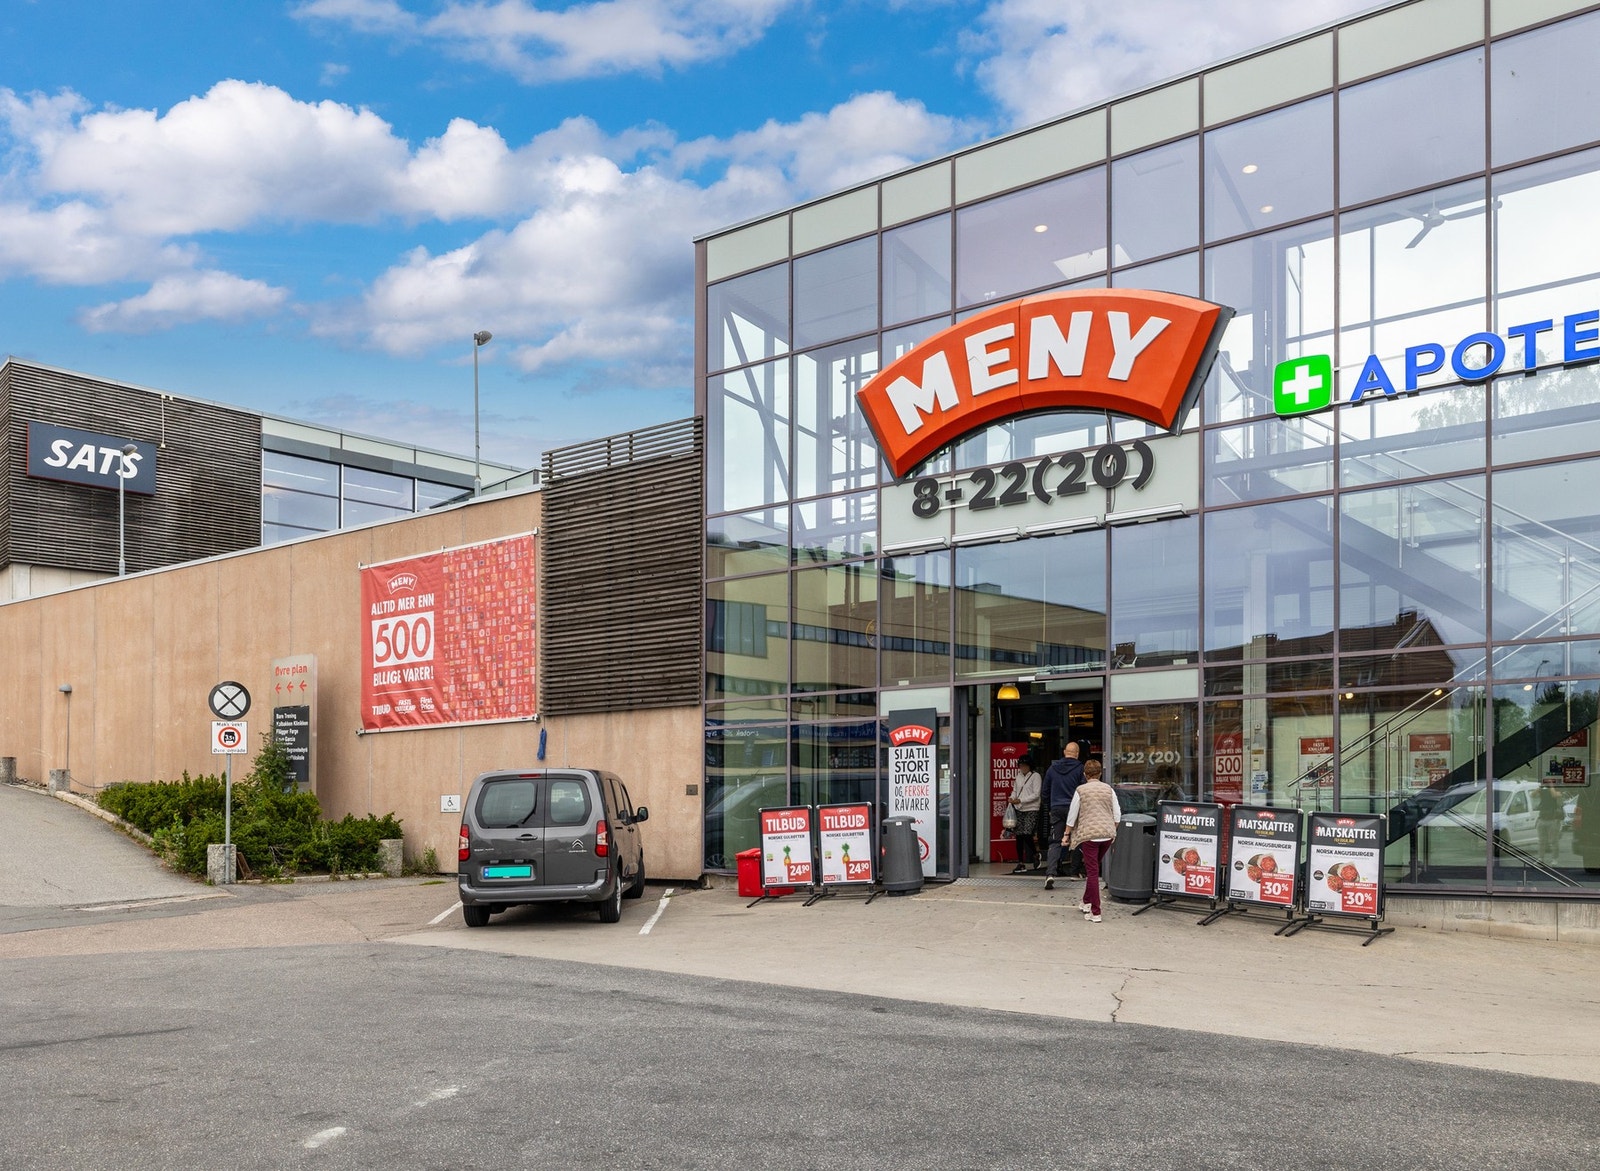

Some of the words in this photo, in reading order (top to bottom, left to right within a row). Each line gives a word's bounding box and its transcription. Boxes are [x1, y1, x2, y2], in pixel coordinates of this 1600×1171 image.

[1350, 310, 1600, 401] APOTE
[885, 311, 1172, 435] MENY
[43, 439, 143, 478] SATS
[391, 576, 414, 589] MENY
[371, 599, 395, 615] ALLTID
[398, 596, 415, 611] MER
[418, 593, 434, 608] ENN
[375, 617, 431, 663] 500
[275, 666, 290, 677] Øvre
[292, 664, 308, 675] plan
[373, 670, 401, 686] BILLIGE
[403, 665, 434, 682] VARER!
[894, 728, 928, 741] MENY
[895, 748, 903, 760] SI
[904, 748, 914, 760] JA
[916, 748, 929, 759] TIL
[1149, 750, 1180, 765] (20)
[894, 760, 929, 773] STORT
[993, 758, 1007, 768] 100
[1217, 757, 1241, 773] 500
[894, 773, 930, 785] UTVALG
[993, 769, 1021, 780] TILBU
[904, 784, 929, 797] FERSKE
[993, 780, 1010, 788] HVER
[895, 797, 930, 812] RÅVARER
[1165, 814, 1215, 827] MATSKATTER
[1239, 819, 1294, 833] MATSKATTER
[1317, 826, 1376, 840] MATSKATTER
[1254, 841, 1292, 849] ANGUSBURGER
[1187, 874, 1211, 887] -30%
[1262, 881, 1289, 896] -30%
[1343, 892, 1373, 906] -30%
